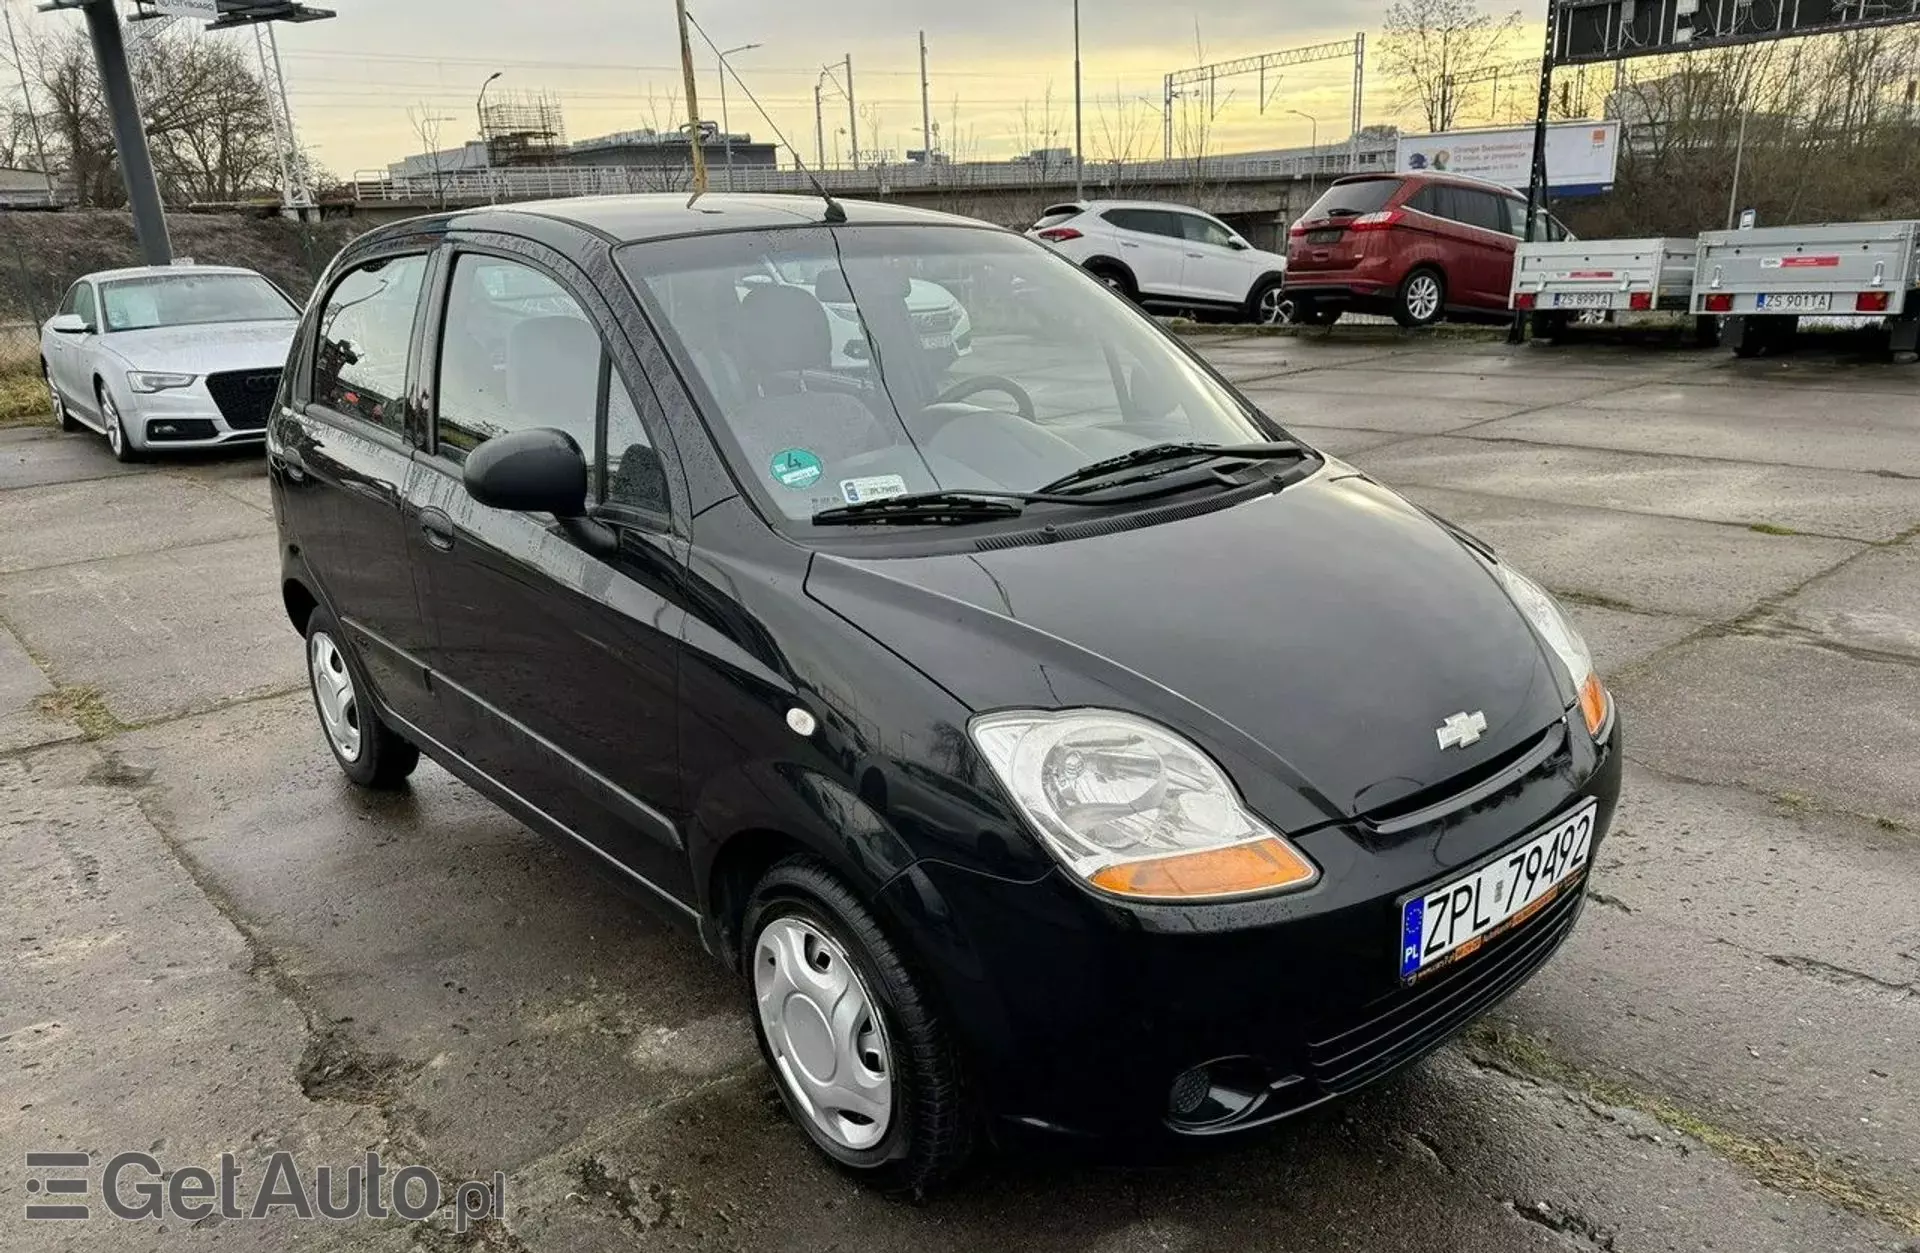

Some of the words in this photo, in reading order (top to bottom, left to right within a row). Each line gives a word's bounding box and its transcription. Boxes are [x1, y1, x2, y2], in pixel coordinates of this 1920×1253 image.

[1766, 295, 1782, 307] ZS
[1787, 295, 1826, 307] 901TA
[787, 453, 801, 468] 4
[1424, 877, 1490, 958] ZPL
[1505, 815, 1590, 913] 79492
[1405, 944, 1418, 964] PL
